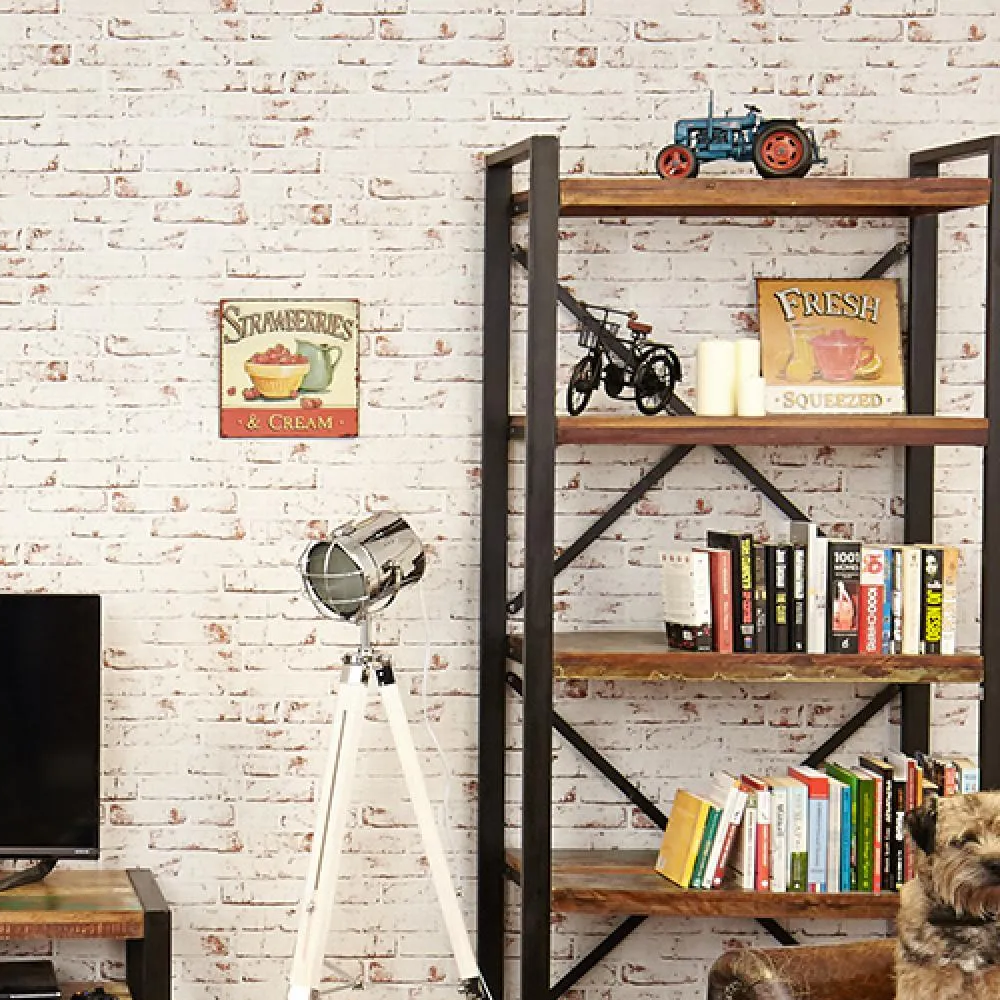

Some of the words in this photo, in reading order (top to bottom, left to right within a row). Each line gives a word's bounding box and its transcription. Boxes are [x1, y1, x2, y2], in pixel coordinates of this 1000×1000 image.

[774, 287, 880, 324] FRESH
[223, 305, 354, 344] STRAWBERRIES
[783, 391, 883, 409] SQUEEZED
[246, 414, 261, 431] &
[268, 414, 333, 432] CREAM
